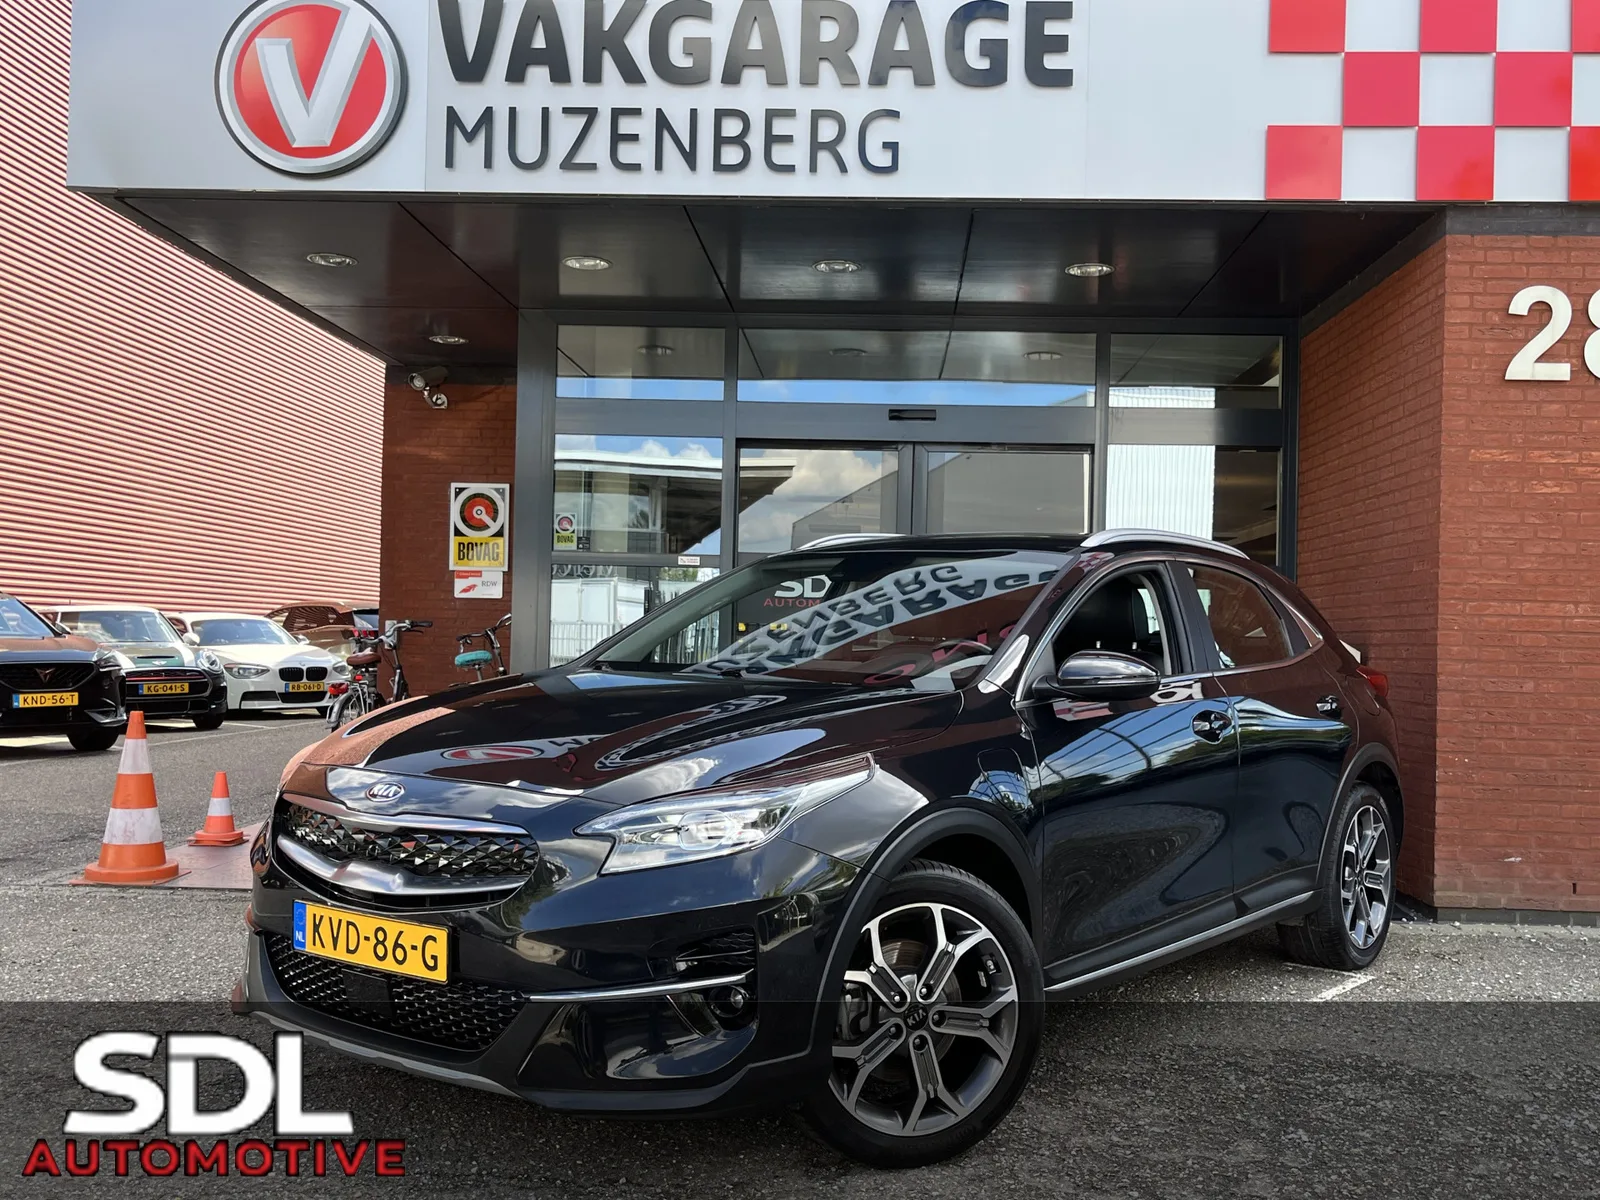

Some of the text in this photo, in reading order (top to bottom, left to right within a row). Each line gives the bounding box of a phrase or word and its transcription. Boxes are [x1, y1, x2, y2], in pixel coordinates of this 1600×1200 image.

[437, 0, 1074, 87] VAKGARAGE
[445, 106, 901, 174] MUZENBERG
[1505, 285, 1600, 380] 2
[556, 535, 574, 543] BOVAG
[458, 542, 500, 561] BOVAG
[147, 684, 185, 693] KG-041-S
[291, 683, 322, 691] RB-061-D
[23, 693, 75, 705] KND-56-T
[370, 783, 401, 798] KIA
[295, 930, 305, 943] NL
[312, 912, 439, 971] KVD-86-G
